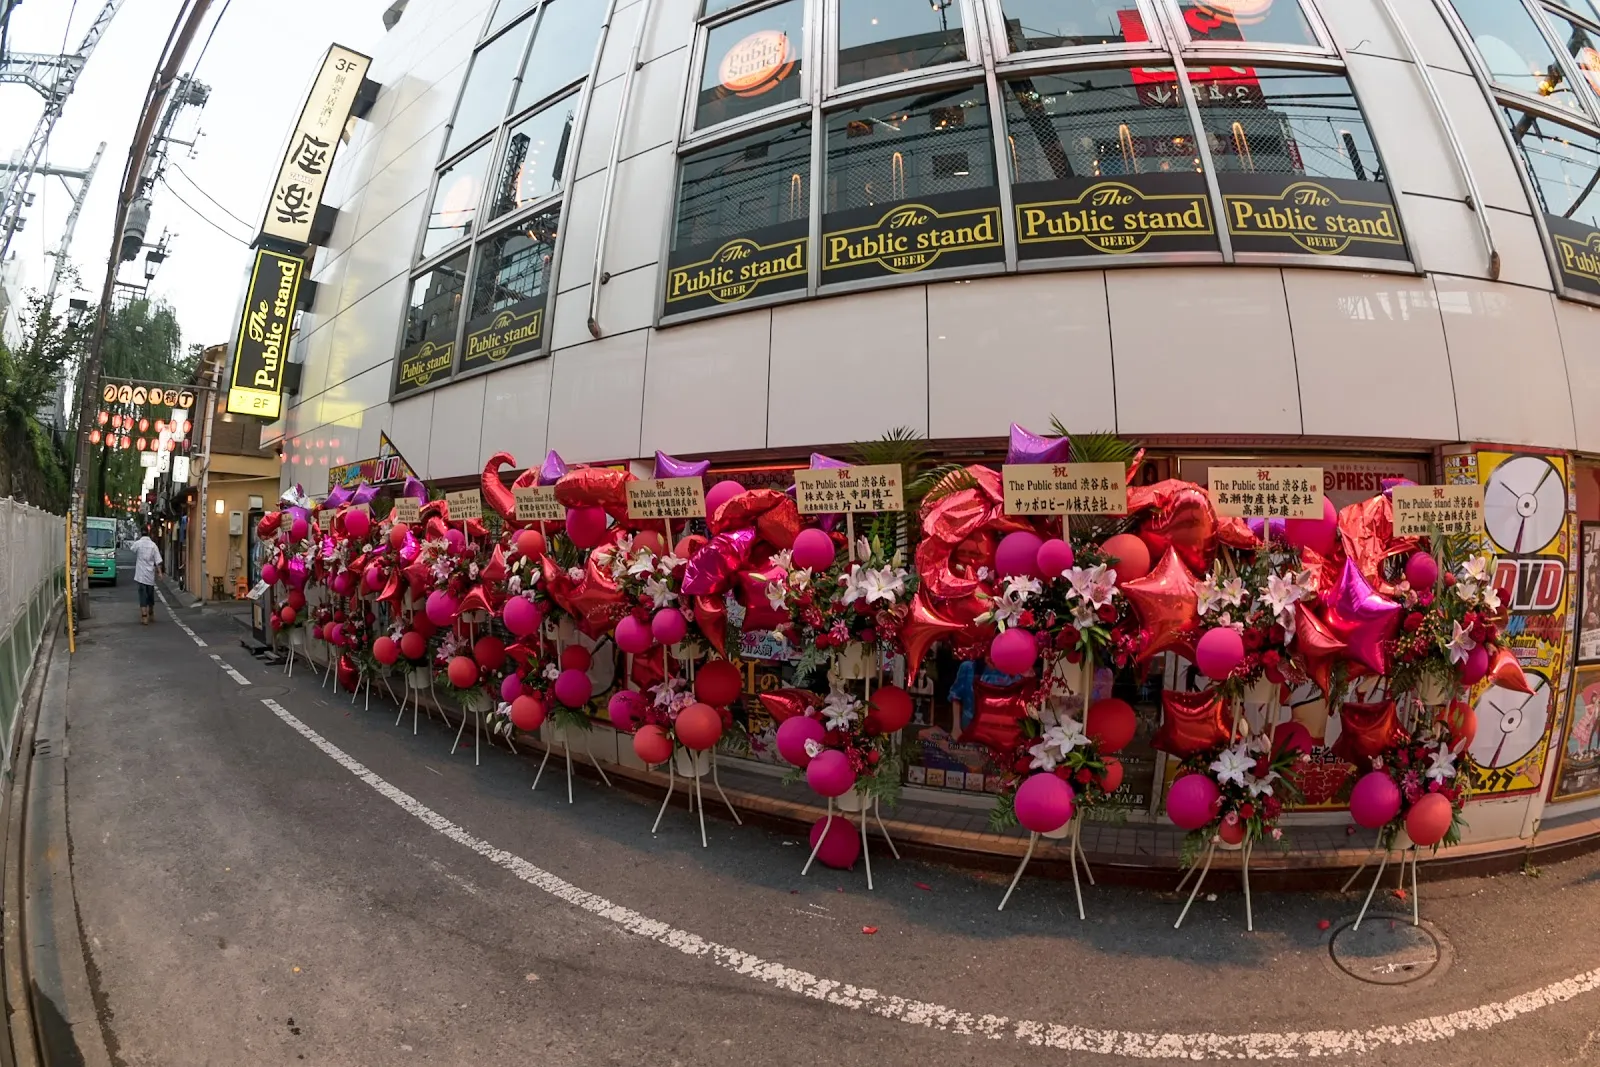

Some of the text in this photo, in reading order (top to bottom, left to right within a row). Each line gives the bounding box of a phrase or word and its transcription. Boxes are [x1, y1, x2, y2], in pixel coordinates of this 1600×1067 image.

[730, 43, 780, 67] Public
[335, 58, 357, 73] 3F
[1092, 189, 1134, 206] The
[1294, 189, 1331, 207] The
[890, 210, 929, 229] The
[1024, 200, 1205, 236] Public stand
[1231, 201, 1394, 238] Public stand
[829, 214, 994, 263] Public stand
[1100, 235, 1135, 247] BEER
[1306, 236, 1338, 248] BEER
[720, 244, 751, 263] The
[893, 254, 926, 267] BEER
[672, 244, 803, 296] Public stand
[720, 284, 746, 298] BEER
[248, 299, 269, 343] The
[254, 260, 297, 388] Public stand
[495, 315, 512, 330] The
[468, 315, 538, 356] Public stand
[402, 347, 451, 380] Public stand
[104, 386, 193, 407] のんべい横丁
[253, 397, 270, 408] 2F
[837, 469, 851, 480] 祝
[1052, 465, 1068, 478] 祝
[1257, 469, 1271, 481] 祝
[800, 481, 814, 490] The
[815, 480, 838, 490] Public
[839, 478, 859, 489] stand
[1009, 480, 1025, 491] The
[1027, 480, 1052, 491] Public
[1055, 479, 1078, 490] stand
[1214, 480, 1229, 491] The
[1232, 480, 1256, 491] Public
[1258, 480, 1280, 491] stand
[1336, 472, 1405, 491] PREST
[629, 490, 639, 499] The
[640, 489, 656, 498] Public
[657, 489, 672, 497] stand
[1433, 487, 1445, 499] 祝
[1397, 499, 1411, 509] The
[1412, 498, 1433, 509] Public
[1434, 498, 1451, 508] stand
[1491, 559, 1565, 611] DVD
